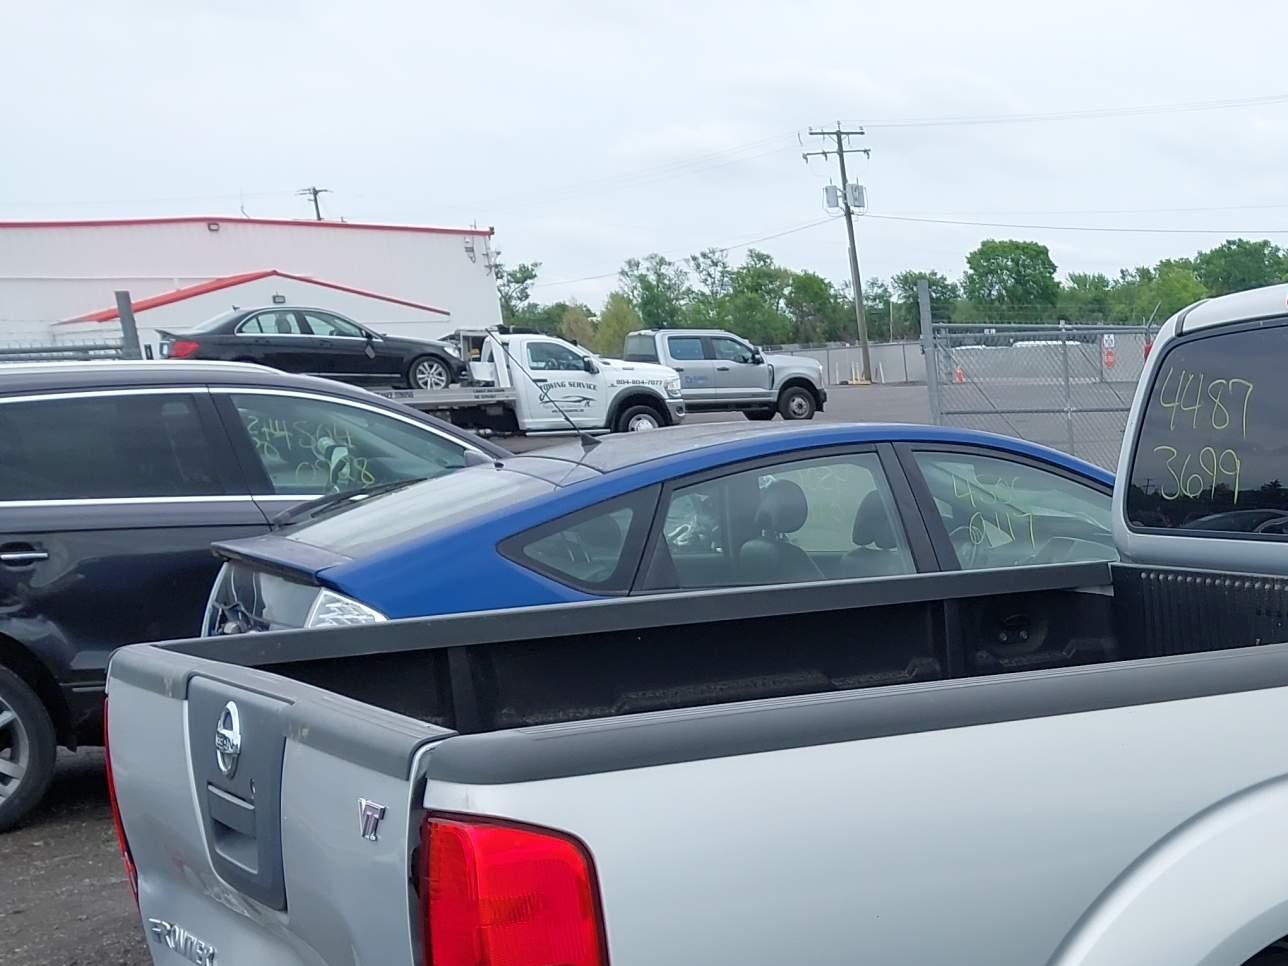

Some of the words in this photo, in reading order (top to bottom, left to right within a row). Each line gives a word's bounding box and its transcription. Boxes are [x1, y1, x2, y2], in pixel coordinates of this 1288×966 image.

[568, 381, 598, 391] SERVICE
[1160, 367, 1253, 439] 4487
[1153, 445, 1240, 505] 3699
